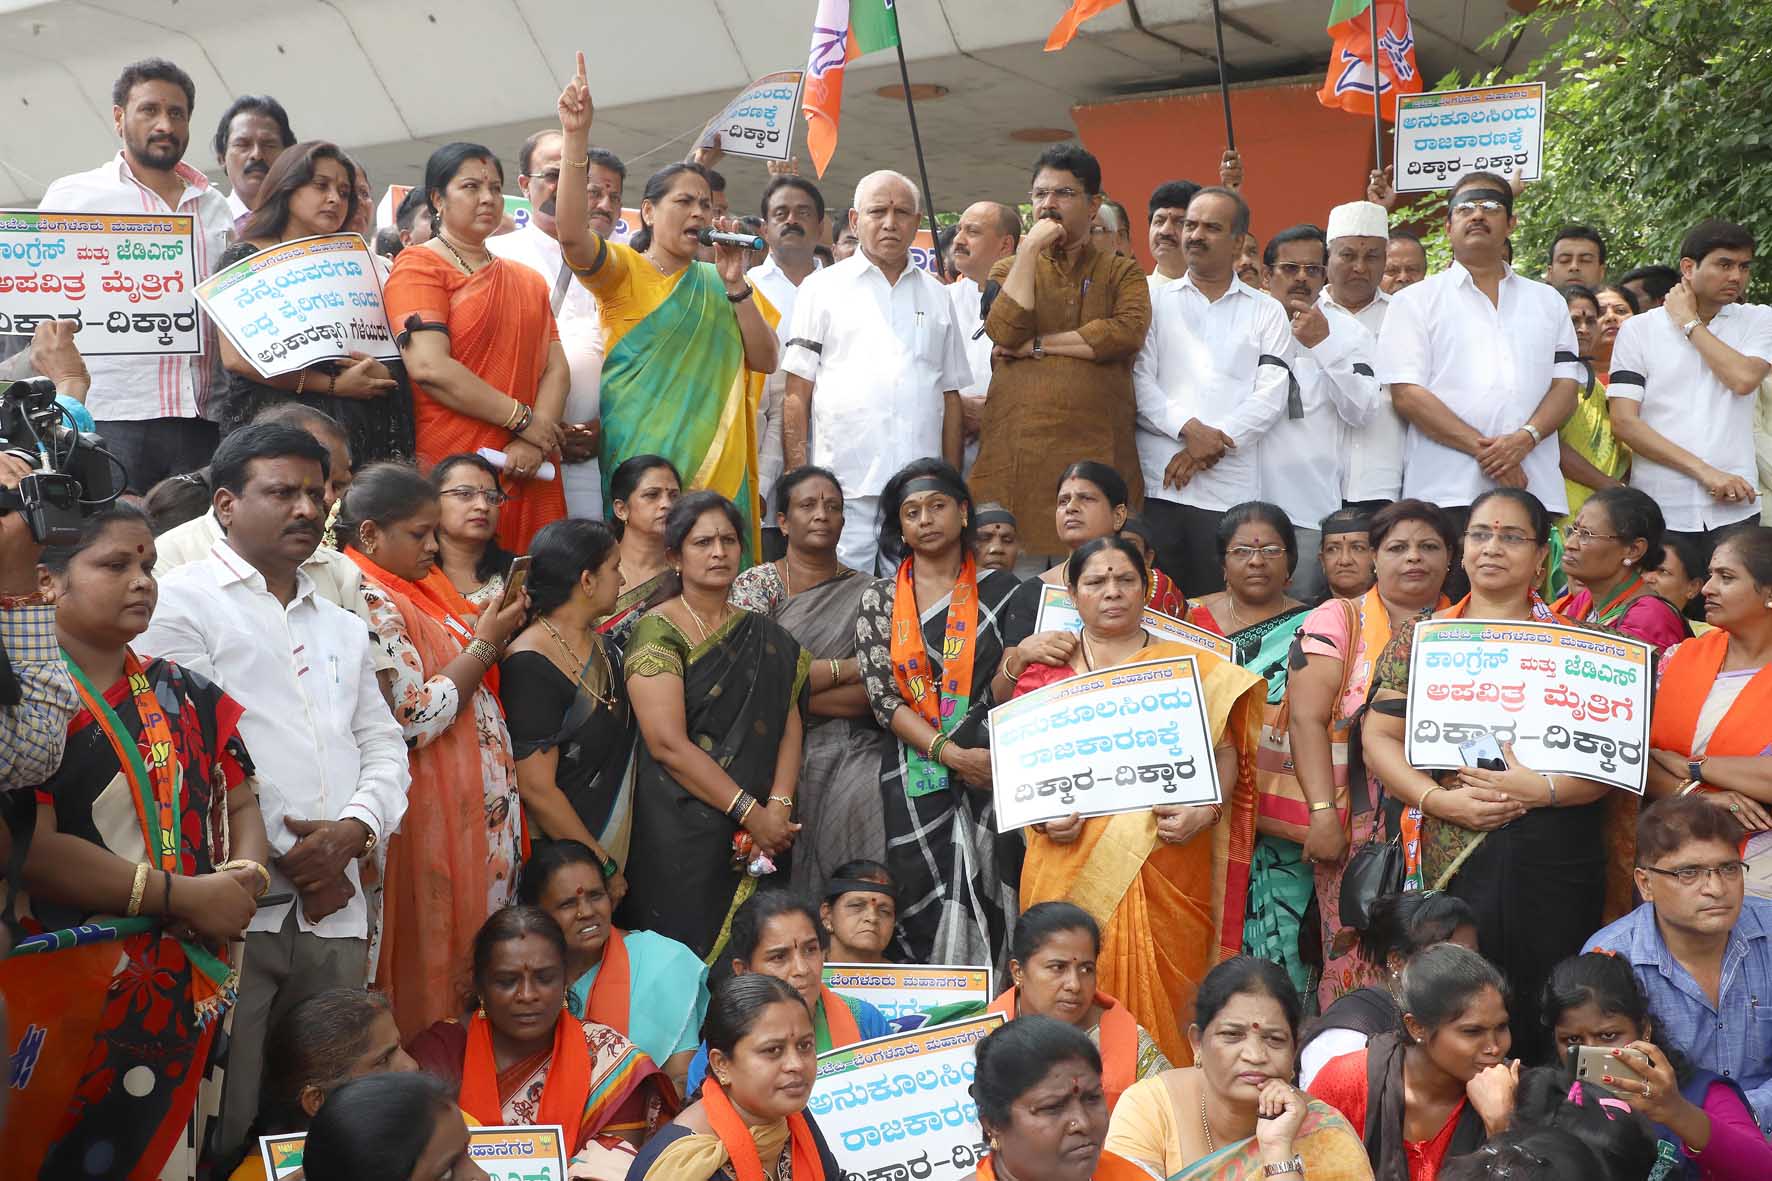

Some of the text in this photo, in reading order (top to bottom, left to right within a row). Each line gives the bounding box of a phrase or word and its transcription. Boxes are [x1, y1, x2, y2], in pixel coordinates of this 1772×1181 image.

[1403, 104, 1537, 130] ಅನುಕೂಲಸಿಂದು
[1413, 127, 1523, 152] ರಾಜಕಾರಣಕ್ಕೆ
[111, 221, 173, 233] ಮಹಾನಗರ
[76, 244, 110, 266] ಮತ್ತು
[116, 238, 184, 261] ಜೆಡಿಎಸ್
[101, 270, 185, 304] ಮೈತ್ರಿಗೆ
[277, 287, 346, 323] ವೈರಿಗಳು
[348, 290, 380, 310] ಇಂದು
[1559, 635, 1627, 657] ಮಹಾನಗರ
[1425, 646, 1638, 687] ಕಾಂಗ್ರೆಸ್ ಮತ್ತು ಜೆಡಿಎಸ್
[999, 687, 1193, 747] ಅನುಕೂಲಸಿಂದು
[1426, 679, 1634, 722] ಅಪವಿತ್ರ ಮೈತ್ರಿಗೆ
[1019, 720, 1184, 769] ರಾಜಕಾರಣಕ್ಕೆ
[903, 975, 968, 988] ಮಹಾನಗರ
[808, 1059, 977, 1116] ಅನುಕೂಲಸಿಂ
[840, 1099, 980, 1152] ರಾಜಕಾರಣ
